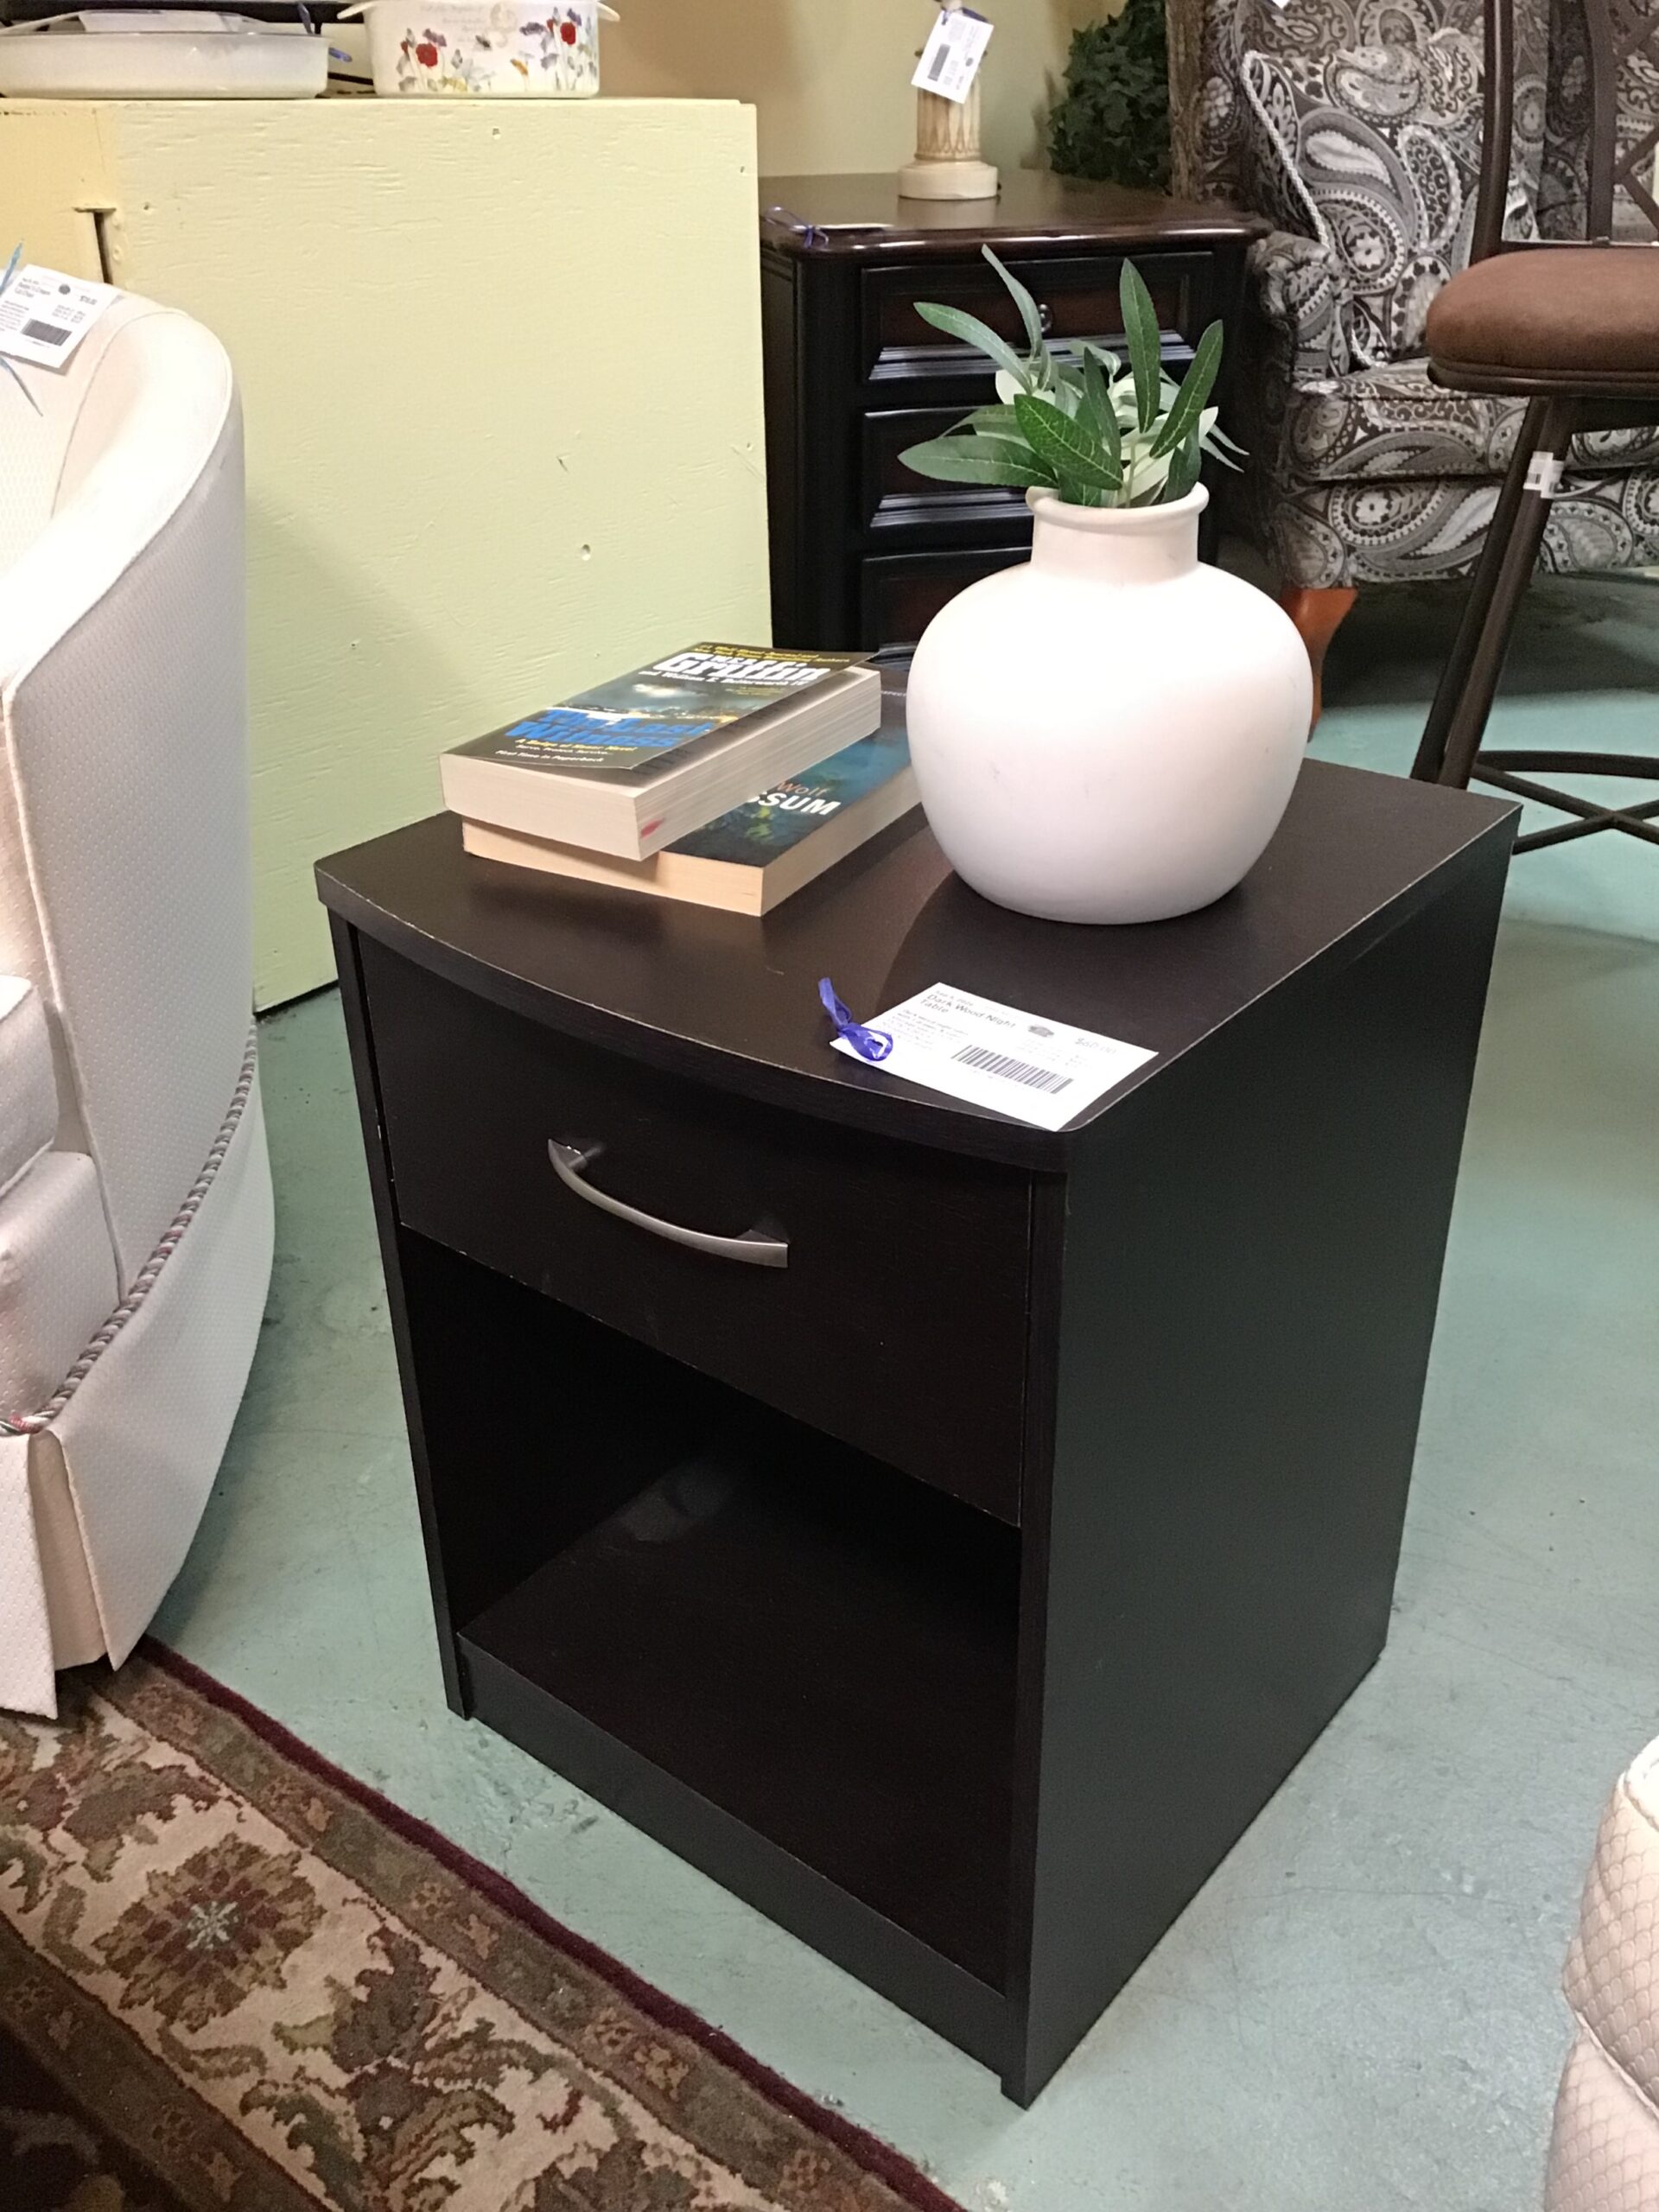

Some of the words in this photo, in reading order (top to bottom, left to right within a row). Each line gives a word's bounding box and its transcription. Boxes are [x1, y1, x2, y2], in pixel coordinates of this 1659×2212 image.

[652, 652, 831, 681] Griffin
[505, 721, 683, 747] Witness
[538, 709, 607, 729] The
[603, 718, 715, 735] Last
[920, 999, 950, 1014] Table
[927, 995, 952, 1007] Dark
[955, 1003, 985, 1019] Wood
[986, 1014, 1017, 1029] Night
